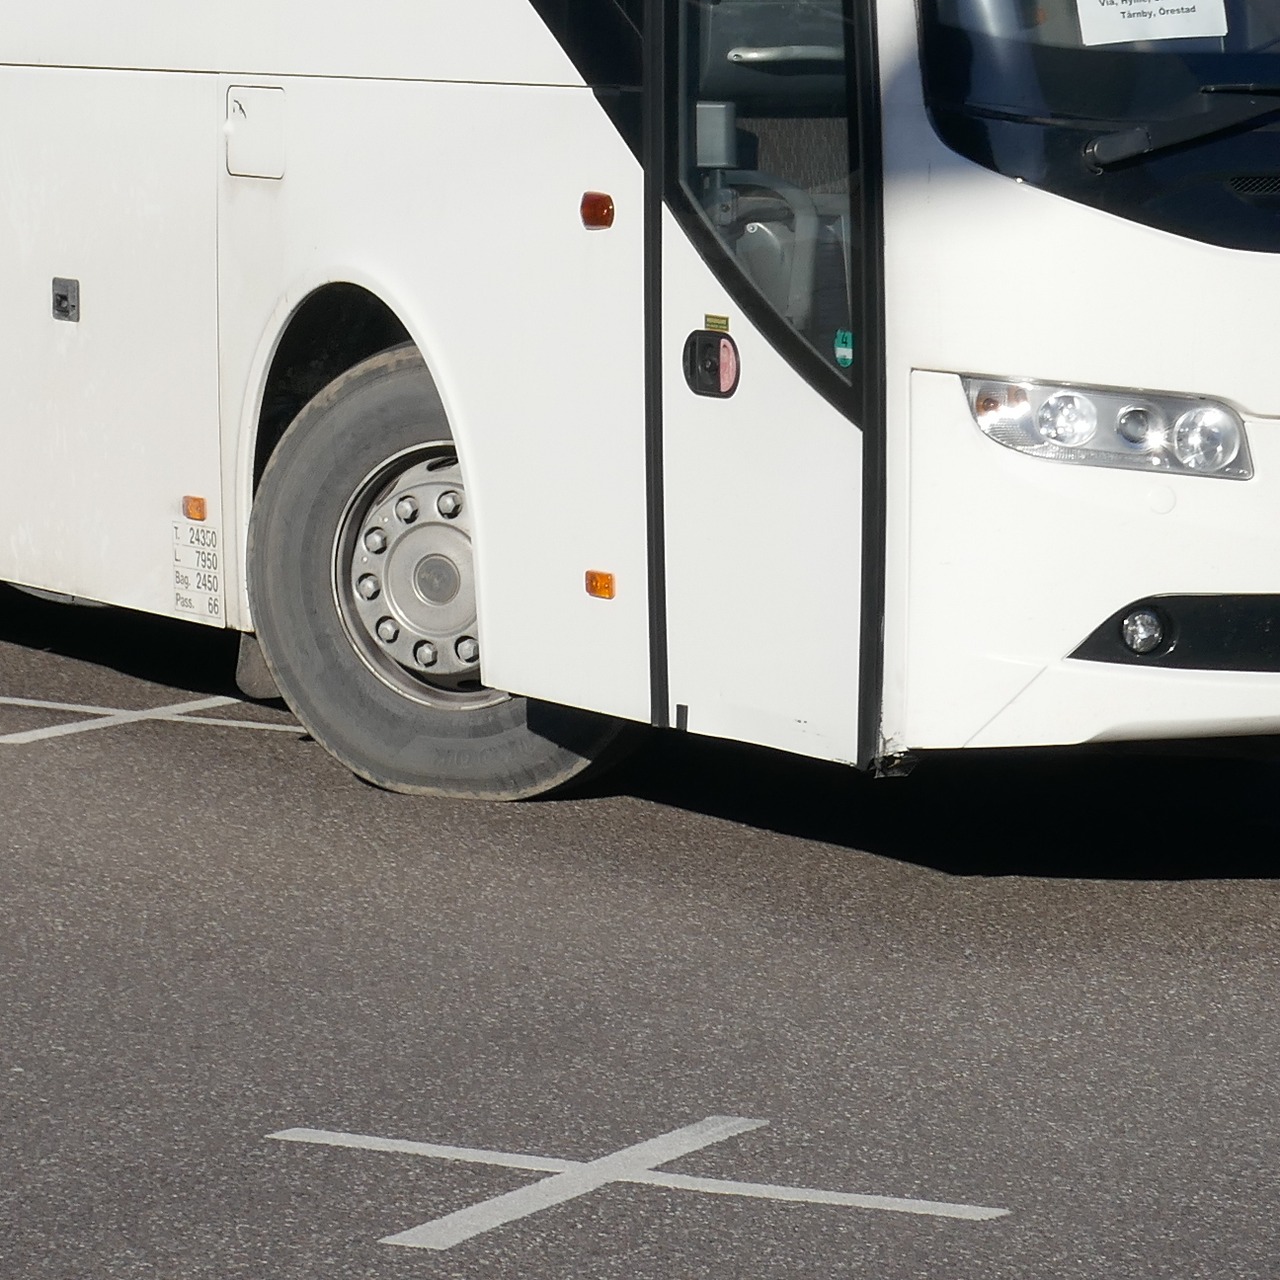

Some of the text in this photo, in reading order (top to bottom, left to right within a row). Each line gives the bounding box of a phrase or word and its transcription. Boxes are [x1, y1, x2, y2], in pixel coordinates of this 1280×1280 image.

[189, 527, 217, 548] 24350
[195, 550, 218, 570] 7950
[195, 572, 219, 592] 2450
[175, 592, 219, 615] Pass. 66
